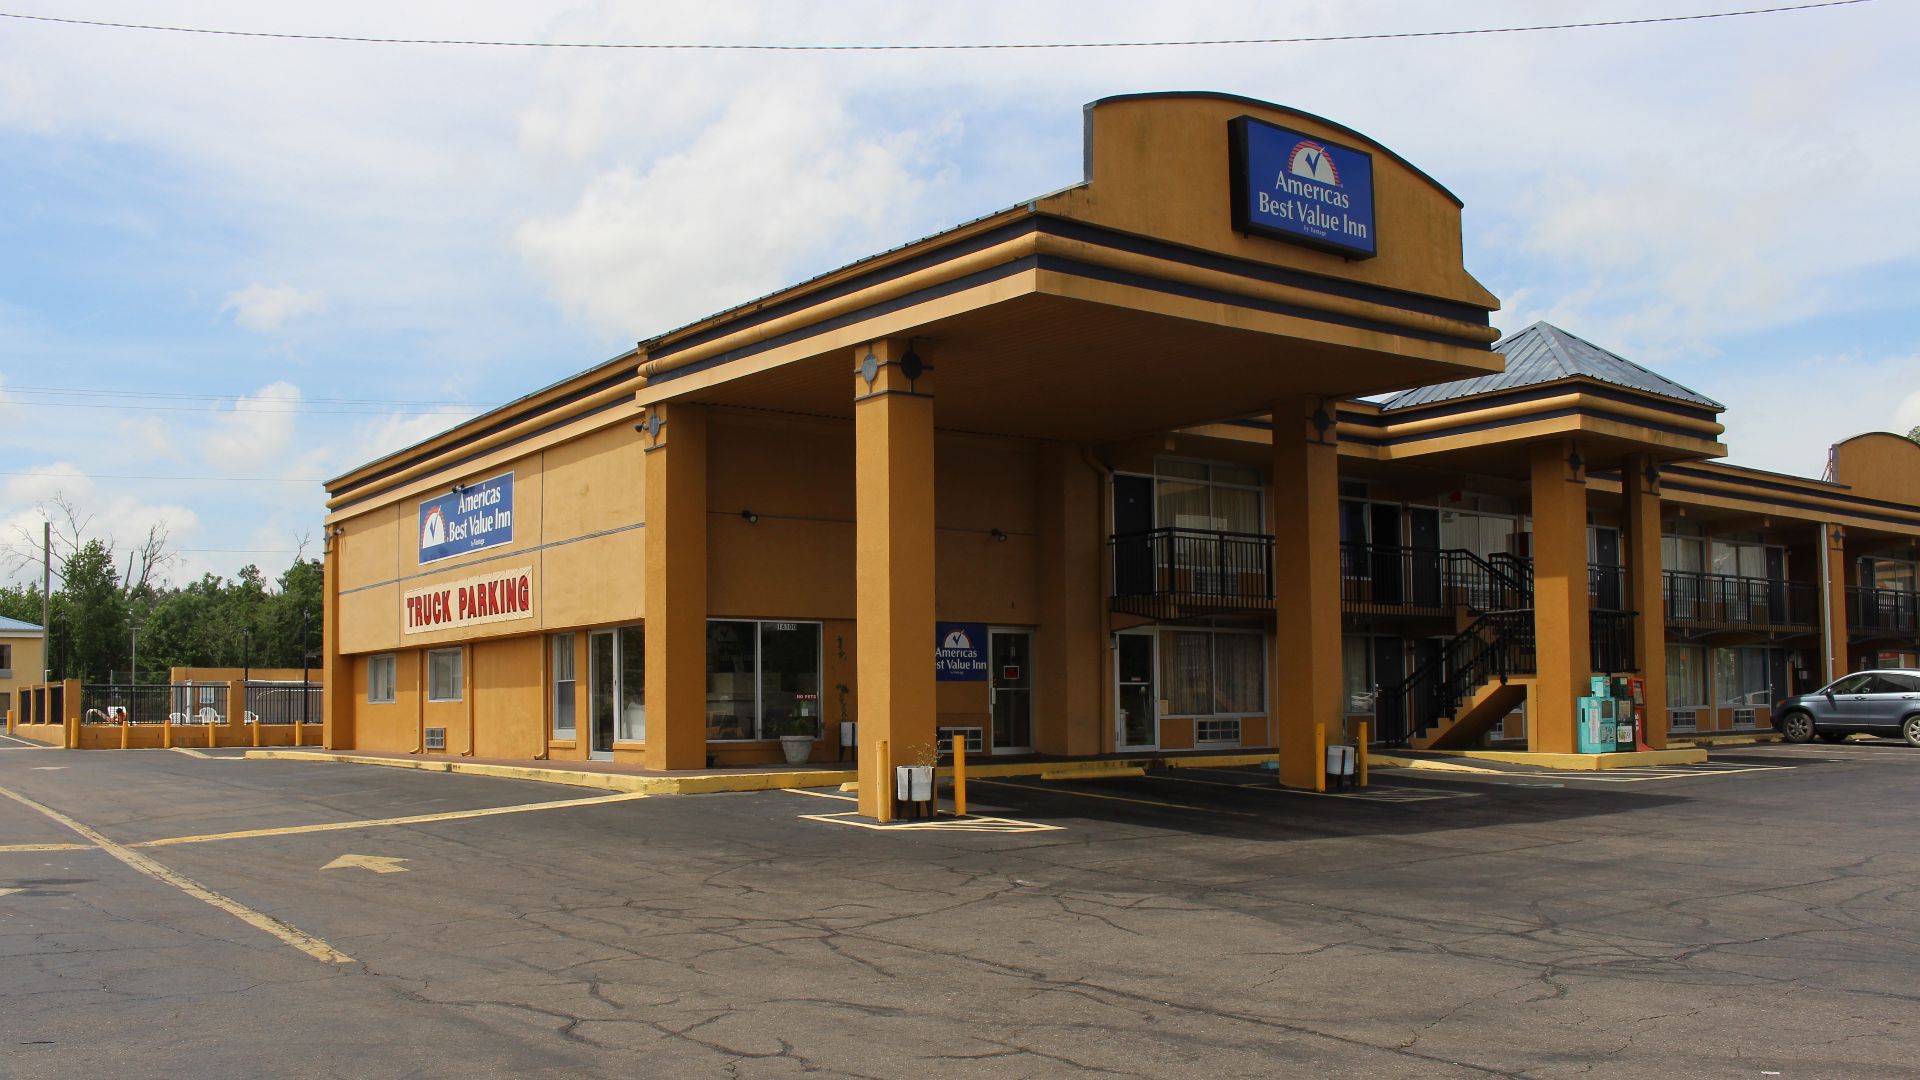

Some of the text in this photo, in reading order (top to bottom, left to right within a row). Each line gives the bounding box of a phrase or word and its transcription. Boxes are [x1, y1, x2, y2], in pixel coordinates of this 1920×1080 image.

[1275, 170, 1349, 209] Americas
[1259, 191, 1367, 239] Best Value Inn
[457, 484, 501, 515] Americas
[449, 507, 511, 542] Best Value Inn
[407, 575, 530, 628] TRUCK PARKING
[935, 646, 978, 658] Americas
[936, 659, 987, 670] st Value Inn
